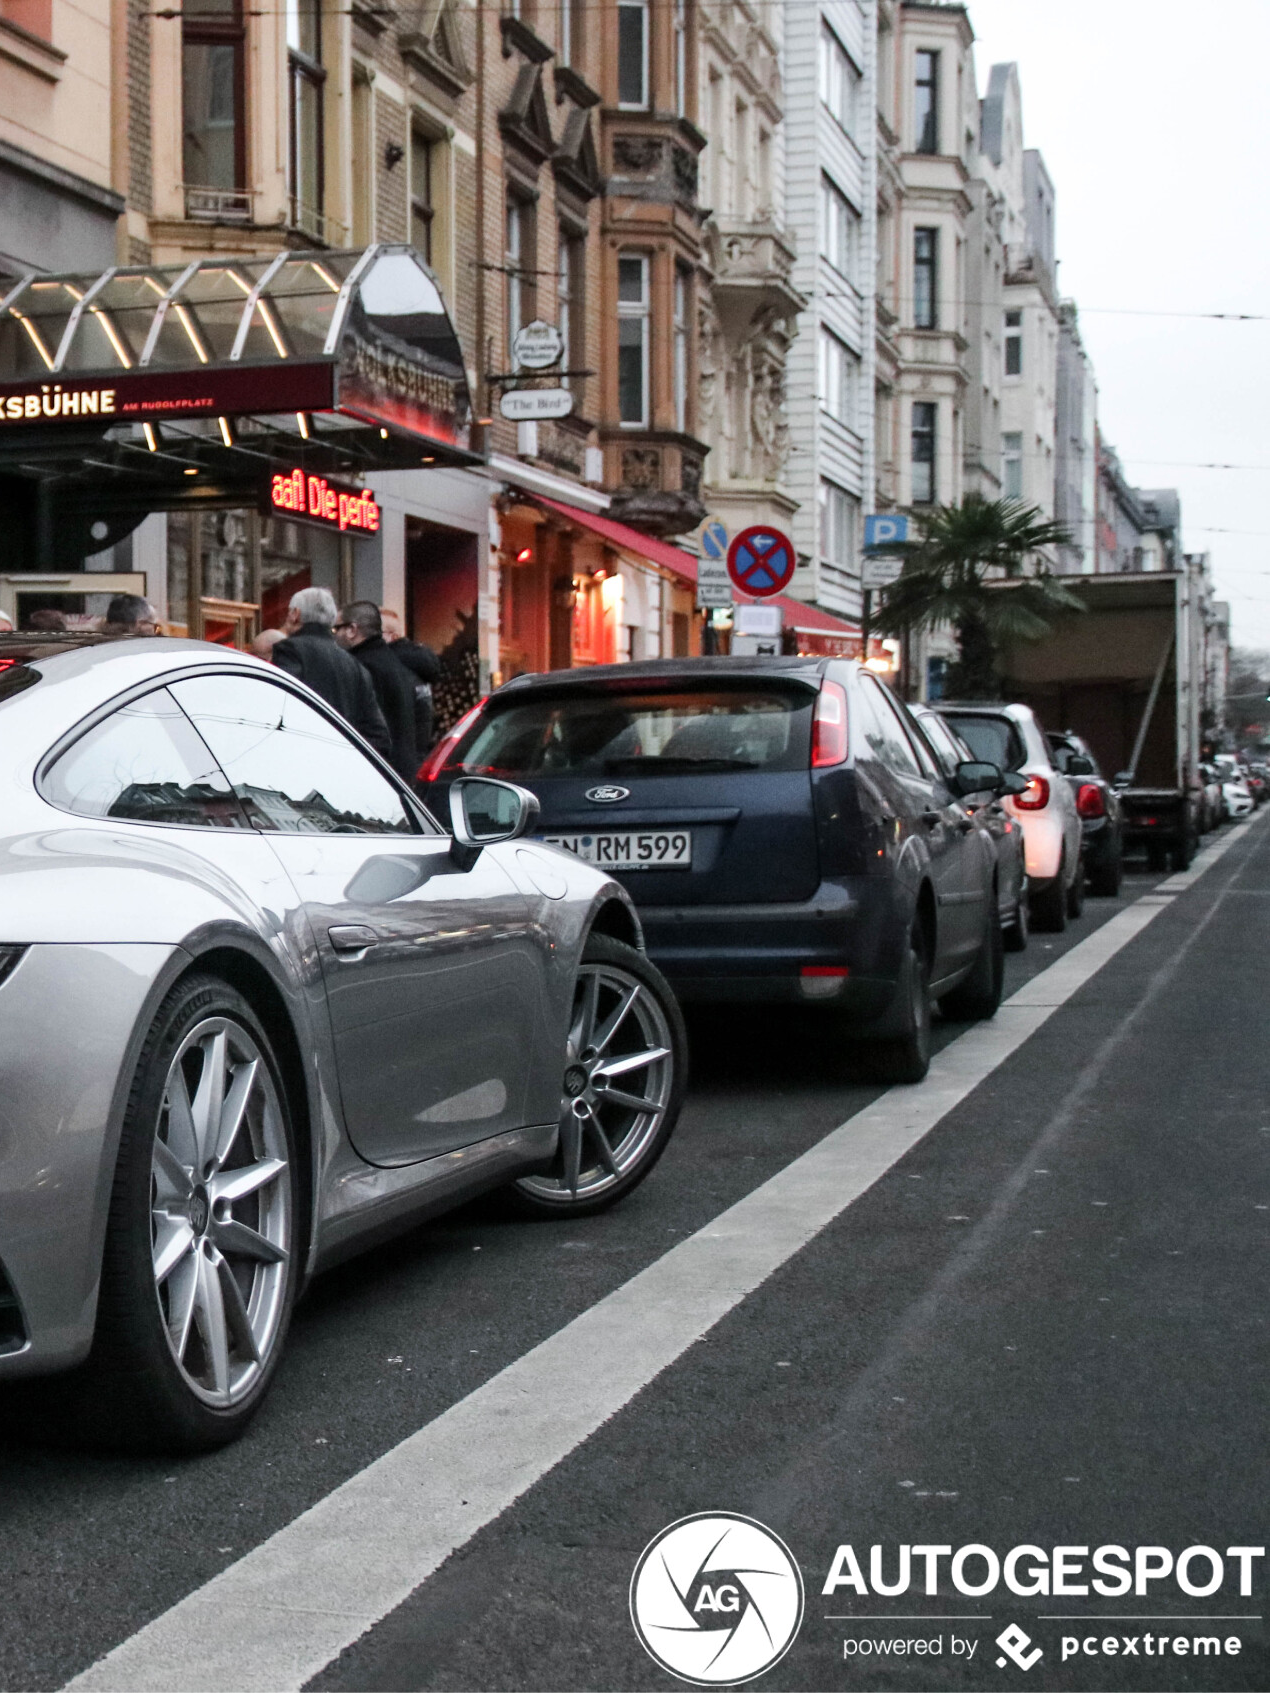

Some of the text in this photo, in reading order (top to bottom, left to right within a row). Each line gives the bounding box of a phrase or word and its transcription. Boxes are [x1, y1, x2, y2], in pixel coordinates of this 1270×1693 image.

[122, 402, 138, 411] AM
[141, 398, 214, 411] RUDOLFPLATZ
[308, 476, 338, 519] Die
[873, 520, 897, 544] P
[594, 788, 619, 799] Ford
[596, 836, 630, 861] RM
[637, 835, 686, 861] 599
